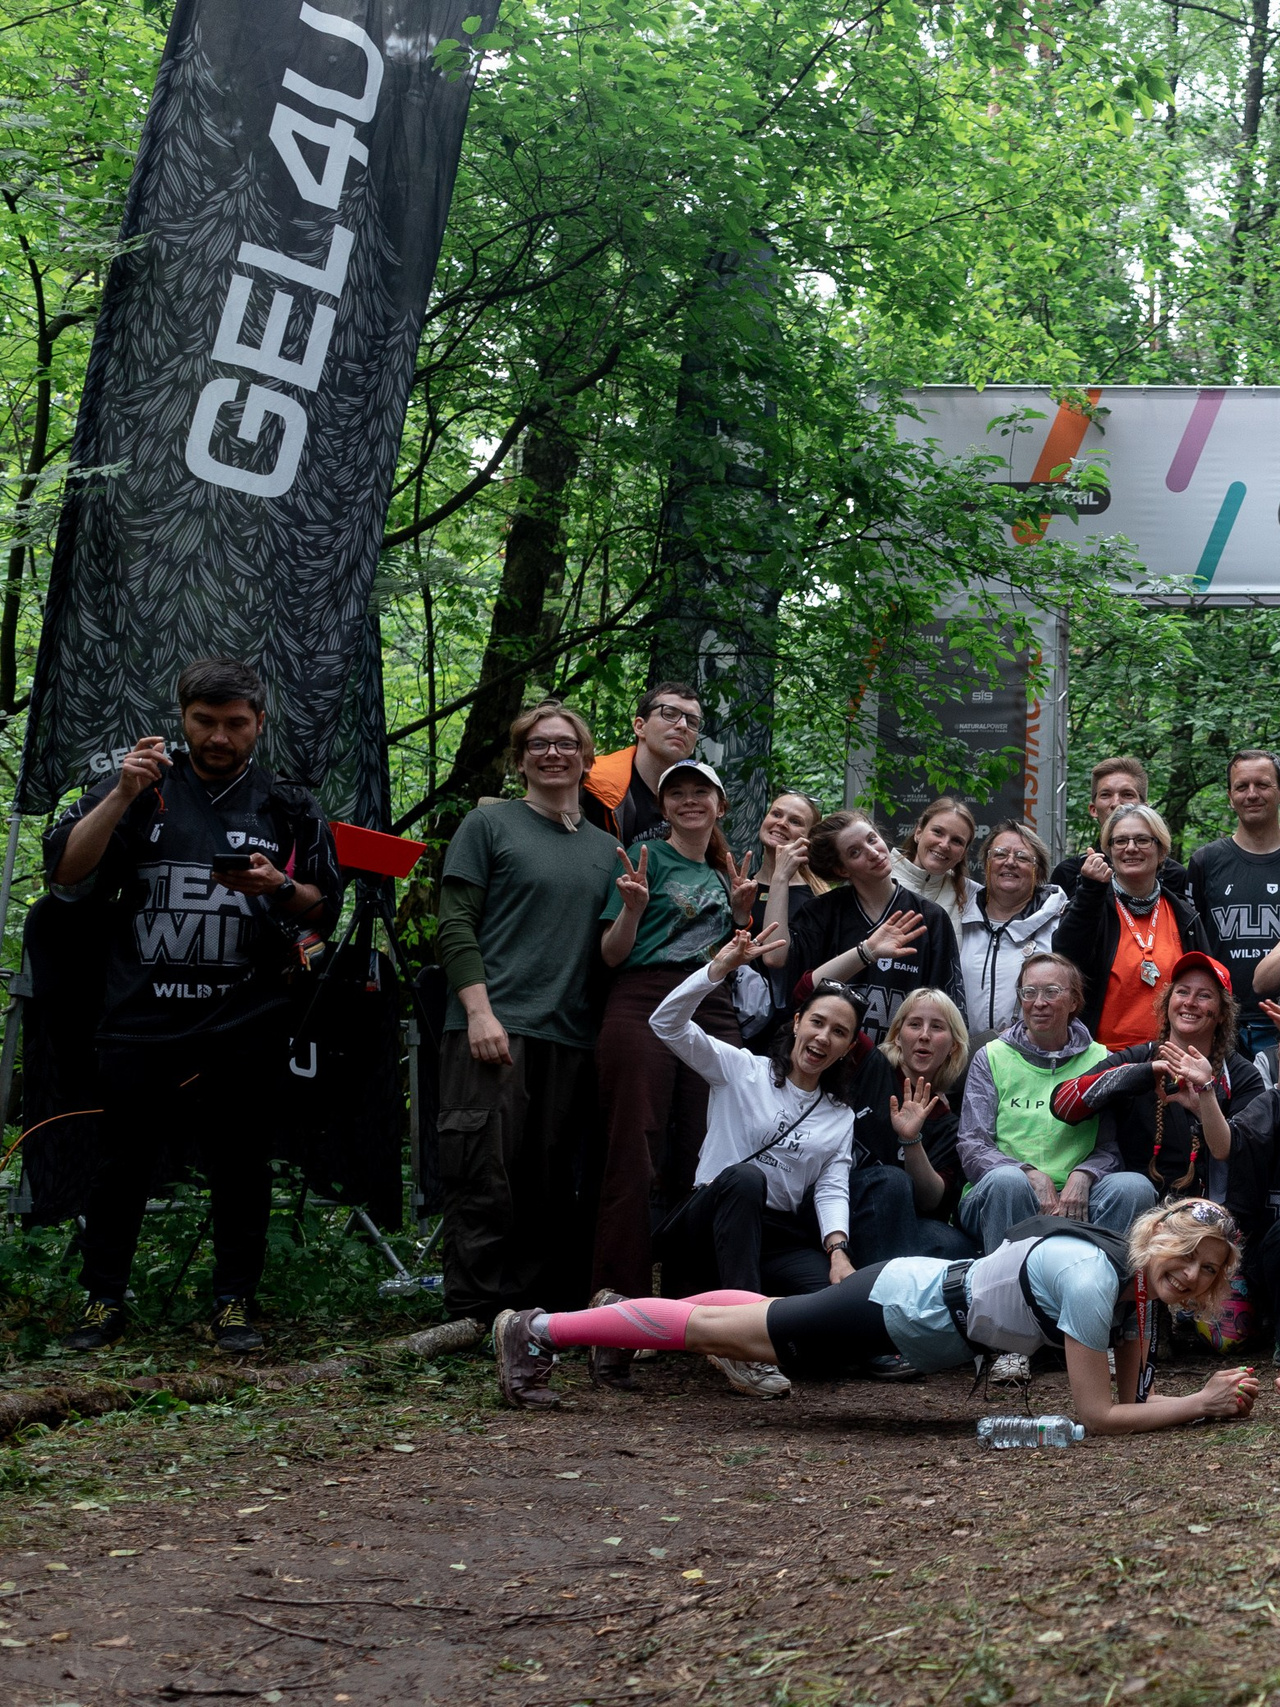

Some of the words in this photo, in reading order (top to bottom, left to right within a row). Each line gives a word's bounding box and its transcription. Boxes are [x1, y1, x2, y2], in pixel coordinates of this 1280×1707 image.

[185, 9, 385, 498] GEL4U
[248, 837, 279, 852] БАН
[136, 861, 254, 916] TEA
[134, 911, 252, 966] WIL
[893, 962, 919, 973] БАНК
